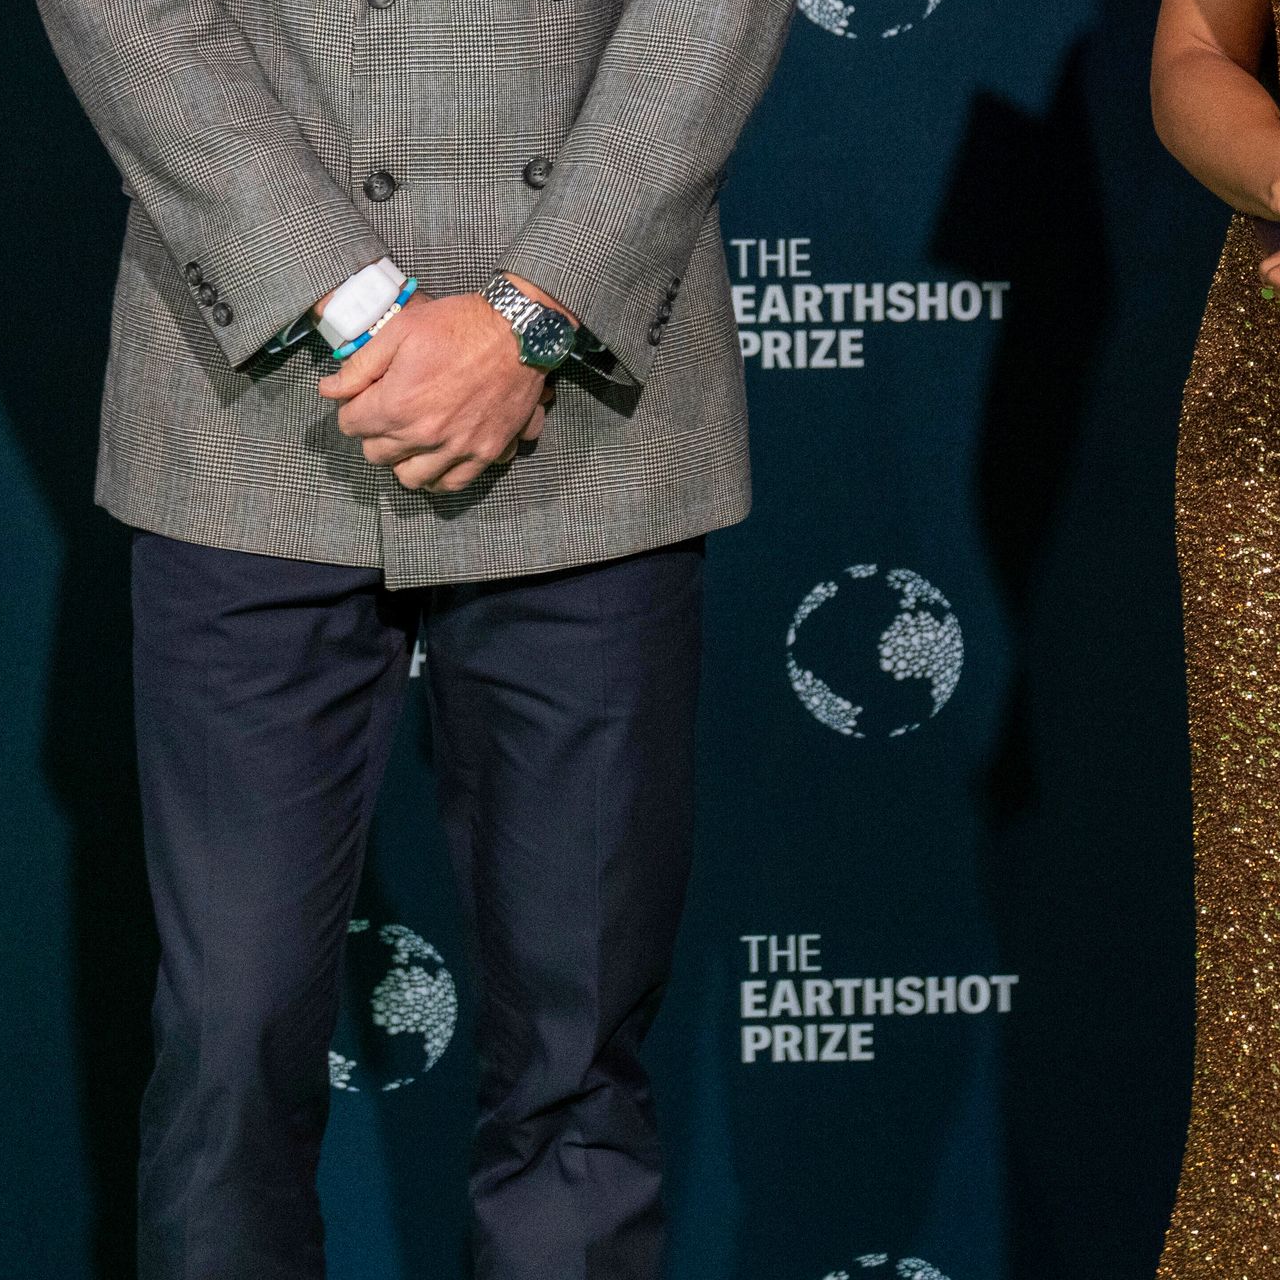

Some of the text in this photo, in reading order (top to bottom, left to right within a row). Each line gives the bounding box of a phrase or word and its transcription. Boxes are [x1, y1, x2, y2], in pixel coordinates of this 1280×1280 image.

[730, 238, 812, 278] THE
[730, 281, 1010, 324] EARTHSHOT
[740, 933, 822, 973] THE
[740, 974, 1019, 1019] EARTHSHOT
[741, 1023, 875, 1064] PRIZE
